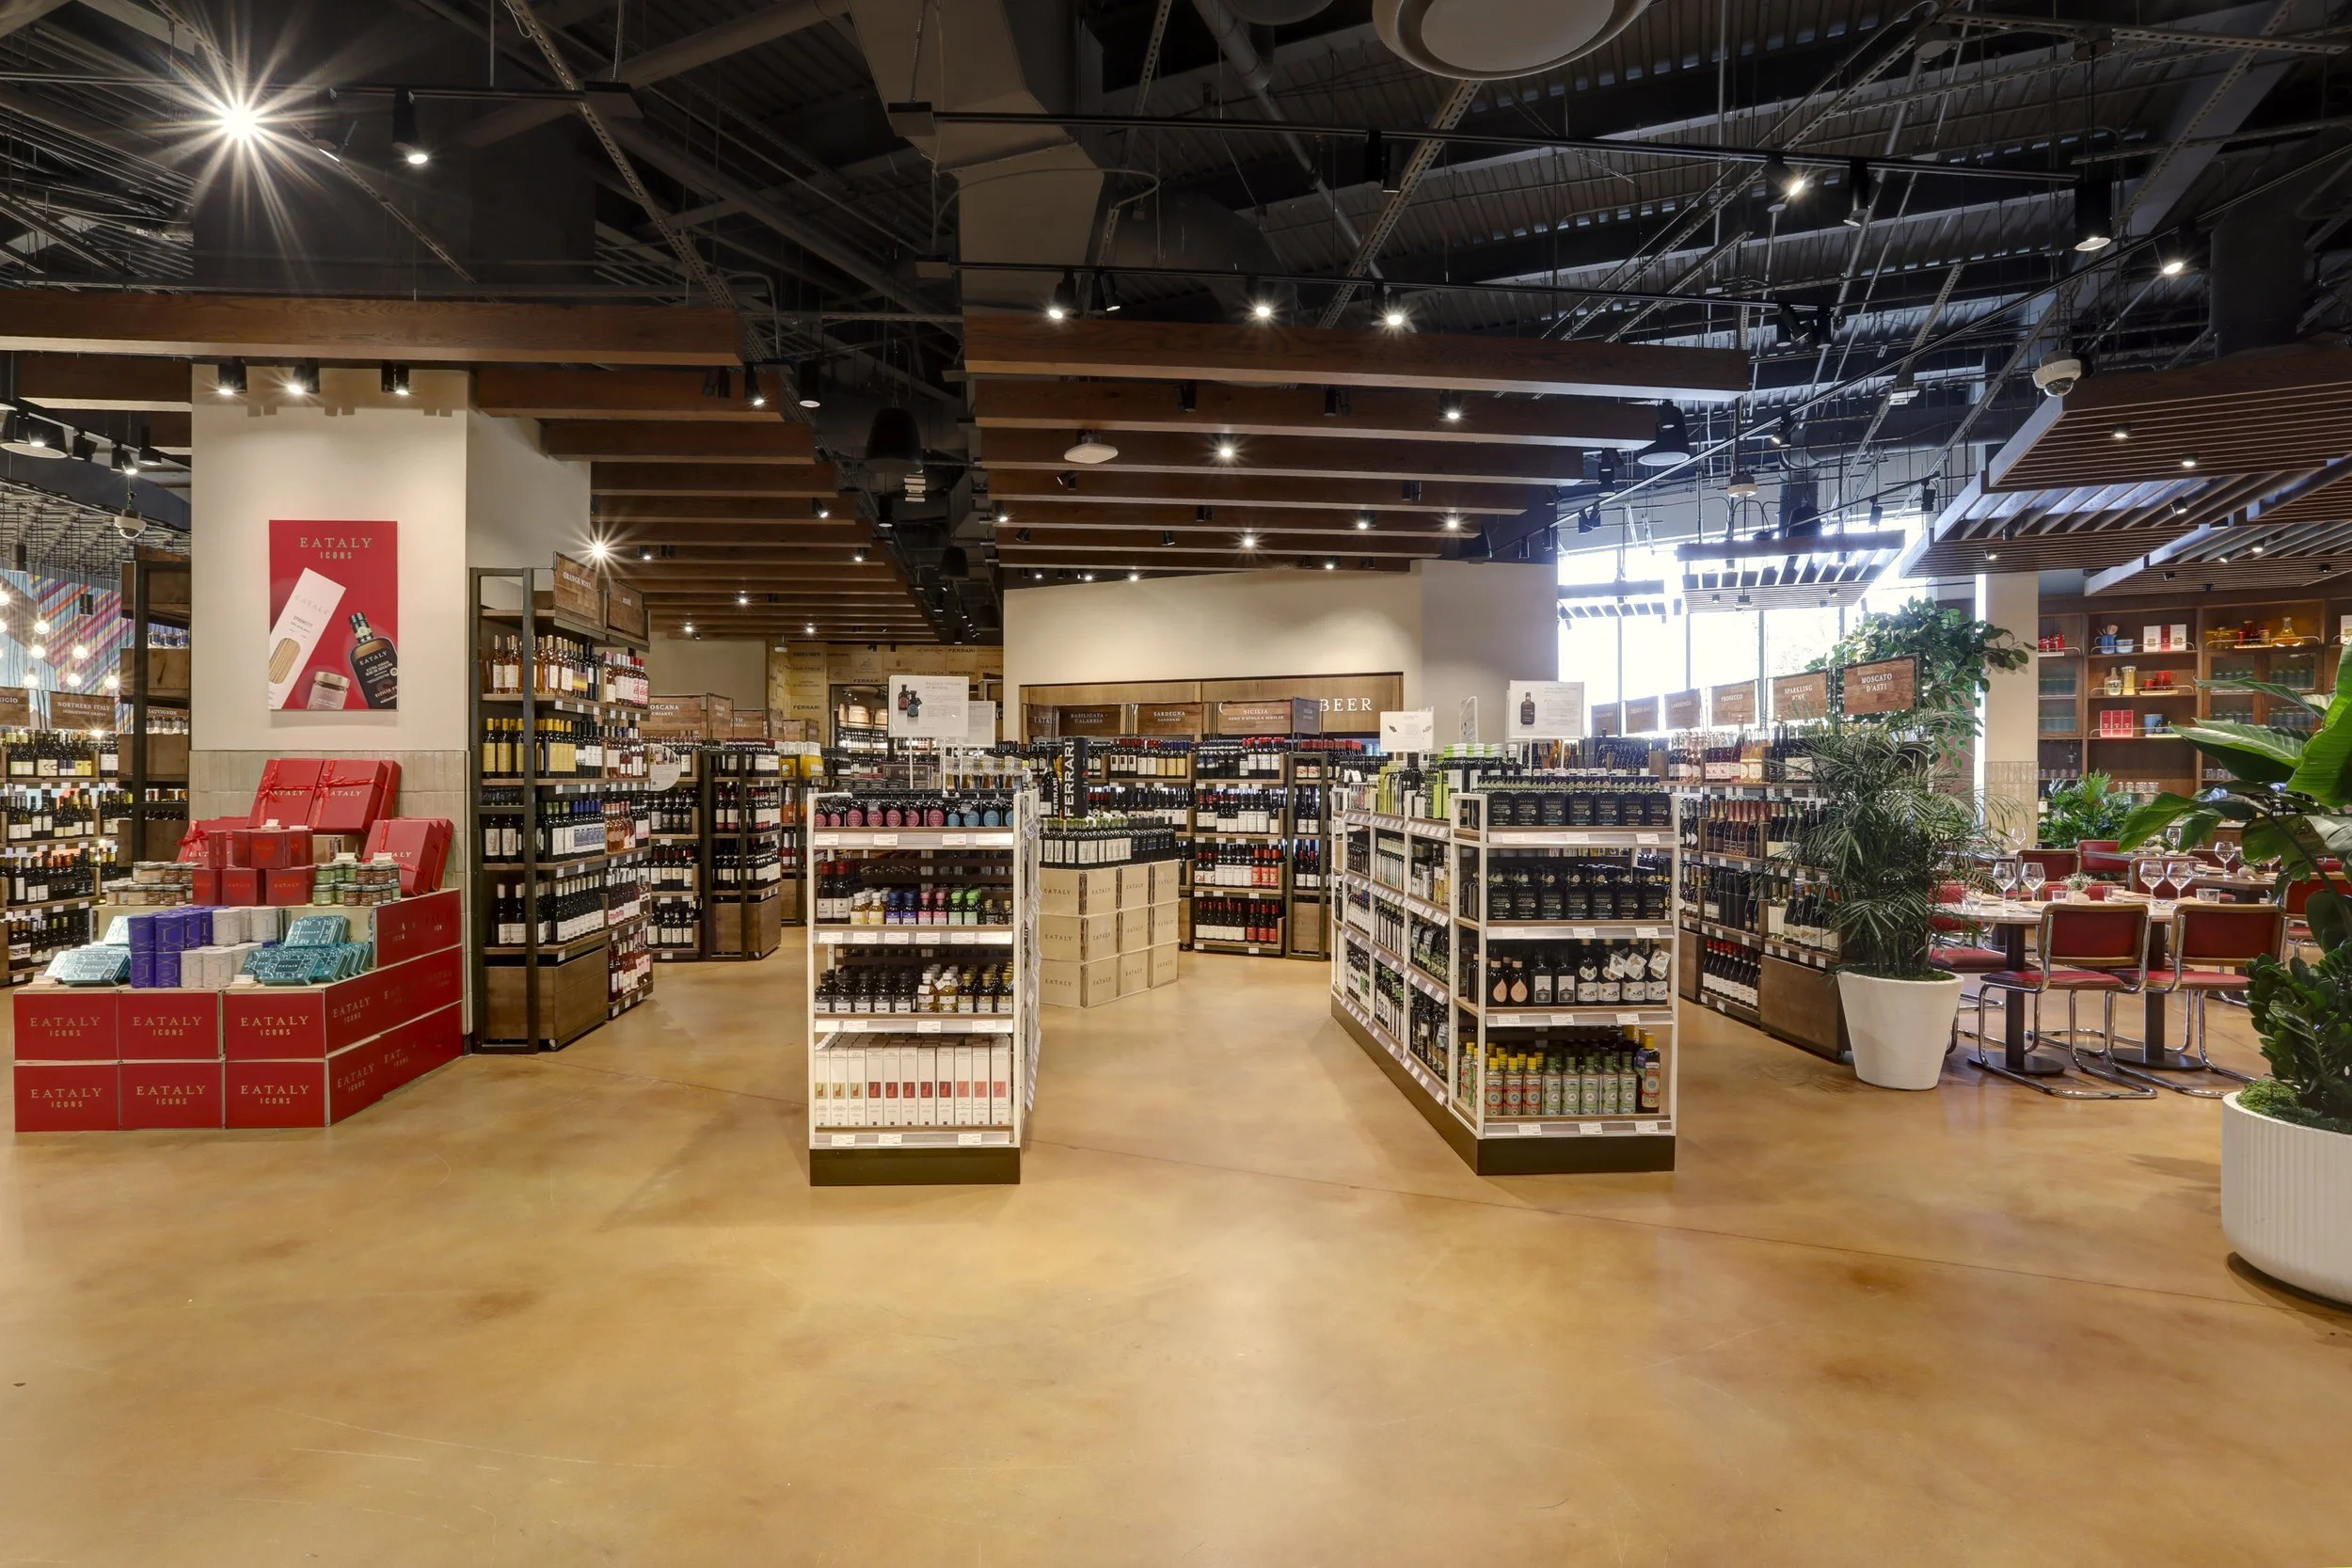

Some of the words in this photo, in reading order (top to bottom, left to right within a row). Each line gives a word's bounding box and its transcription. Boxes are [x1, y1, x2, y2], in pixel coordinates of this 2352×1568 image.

[299, 537, 373, 547] EATALY
[359, 651, 388, 666] EATALY
[1861, 673, 1893, 685] MOSCATO
[1784, 685, 1813, 694] SPARKLING
[1866, 683, 1887, 692] D'ASTI
[1319, 698, 1373, 712] BEER
[1065, 737, 1074, 816] FERRARI
[1093, 977, 1112, 986] EATALY
[333, 996, 372, 1019] EATALY
[30, 1016, 100, 1027] EATALY
[134, 1016, 202, 1026] EATALY
[241, 1016, 309, 1027] EATALY
[337, 1063, 375, 1088] EATALY
[30, 1087, 103, 1099] EATALY
[135, 1085, 207, 1096] EATALY
[240, 1085, 309, 1095] EATALY
